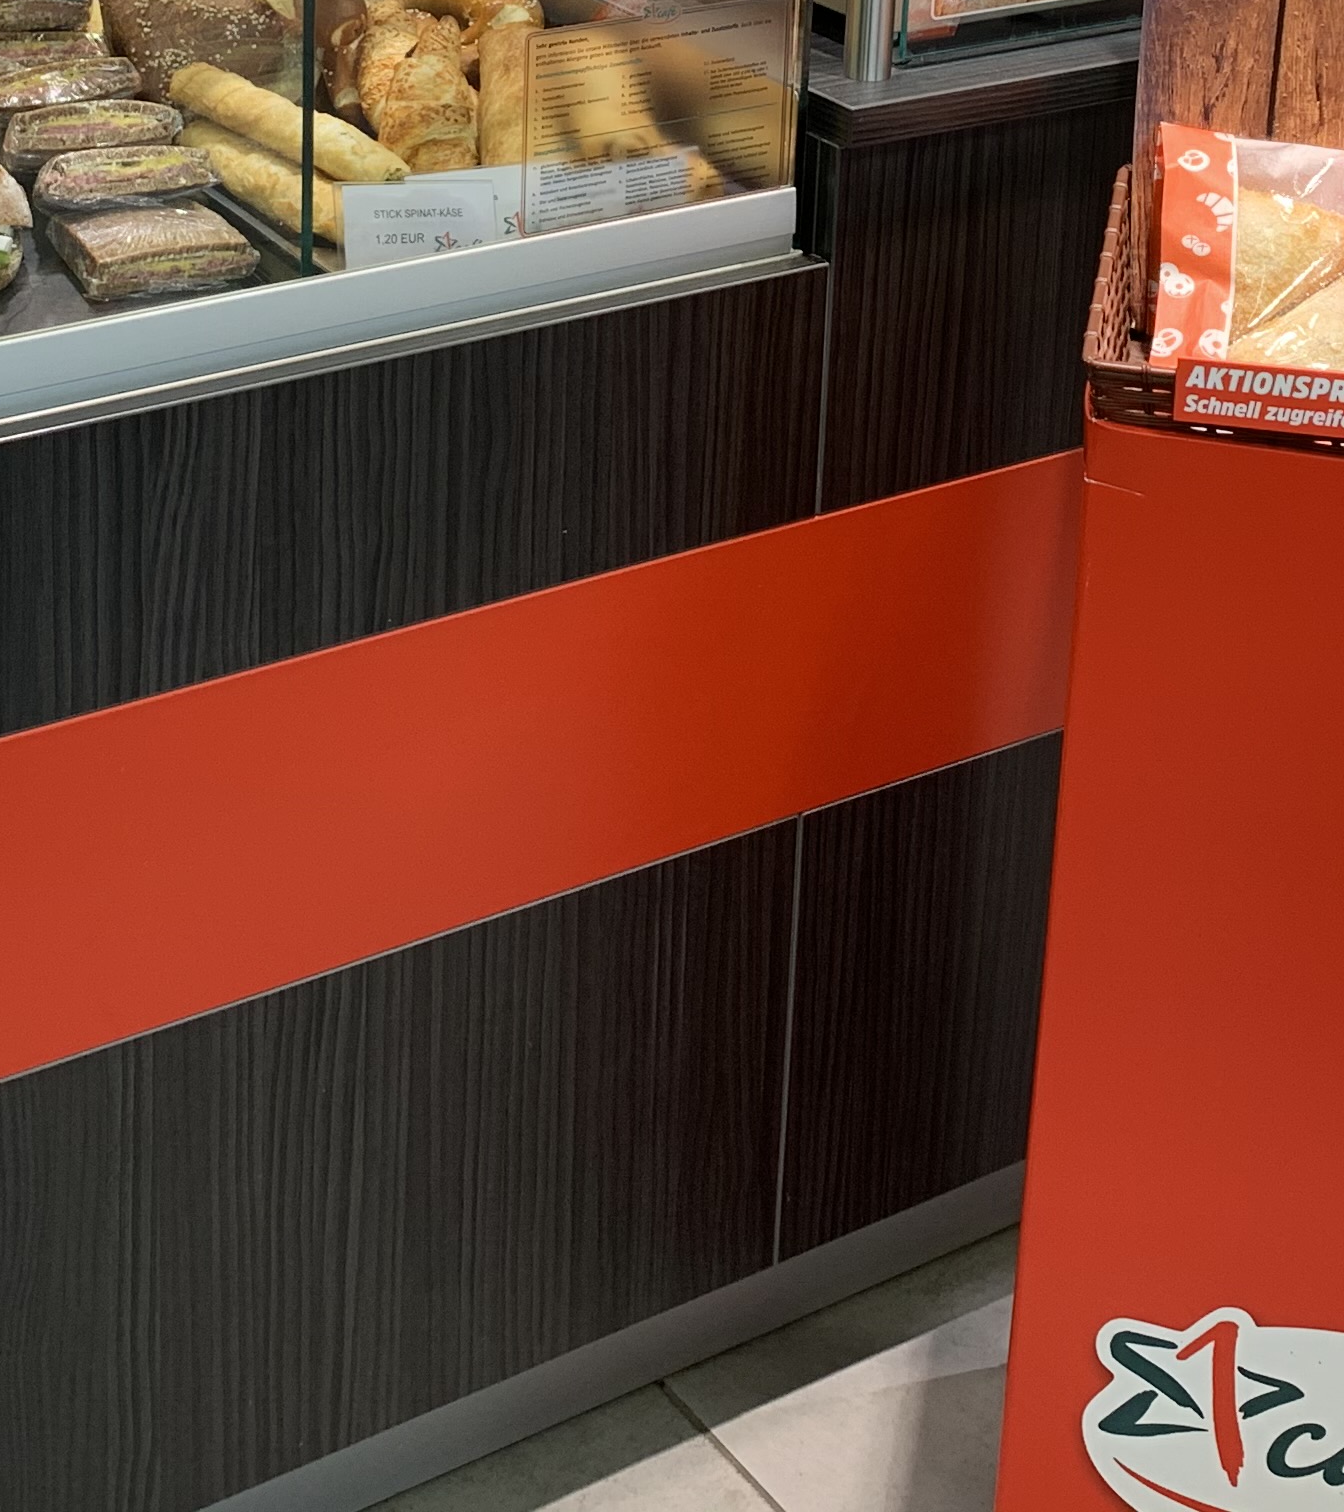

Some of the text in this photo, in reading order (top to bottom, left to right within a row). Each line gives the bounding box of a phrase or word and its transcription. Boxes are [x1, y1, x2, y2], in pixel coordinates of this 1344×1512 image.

[373, 206, 463, 219] STICK SPINAT-KÄSE
[375, 233, 396, 245] 1,20
[398, 232, 425, 245] EUR
[1184, 394, 1261, 419] Schnell
